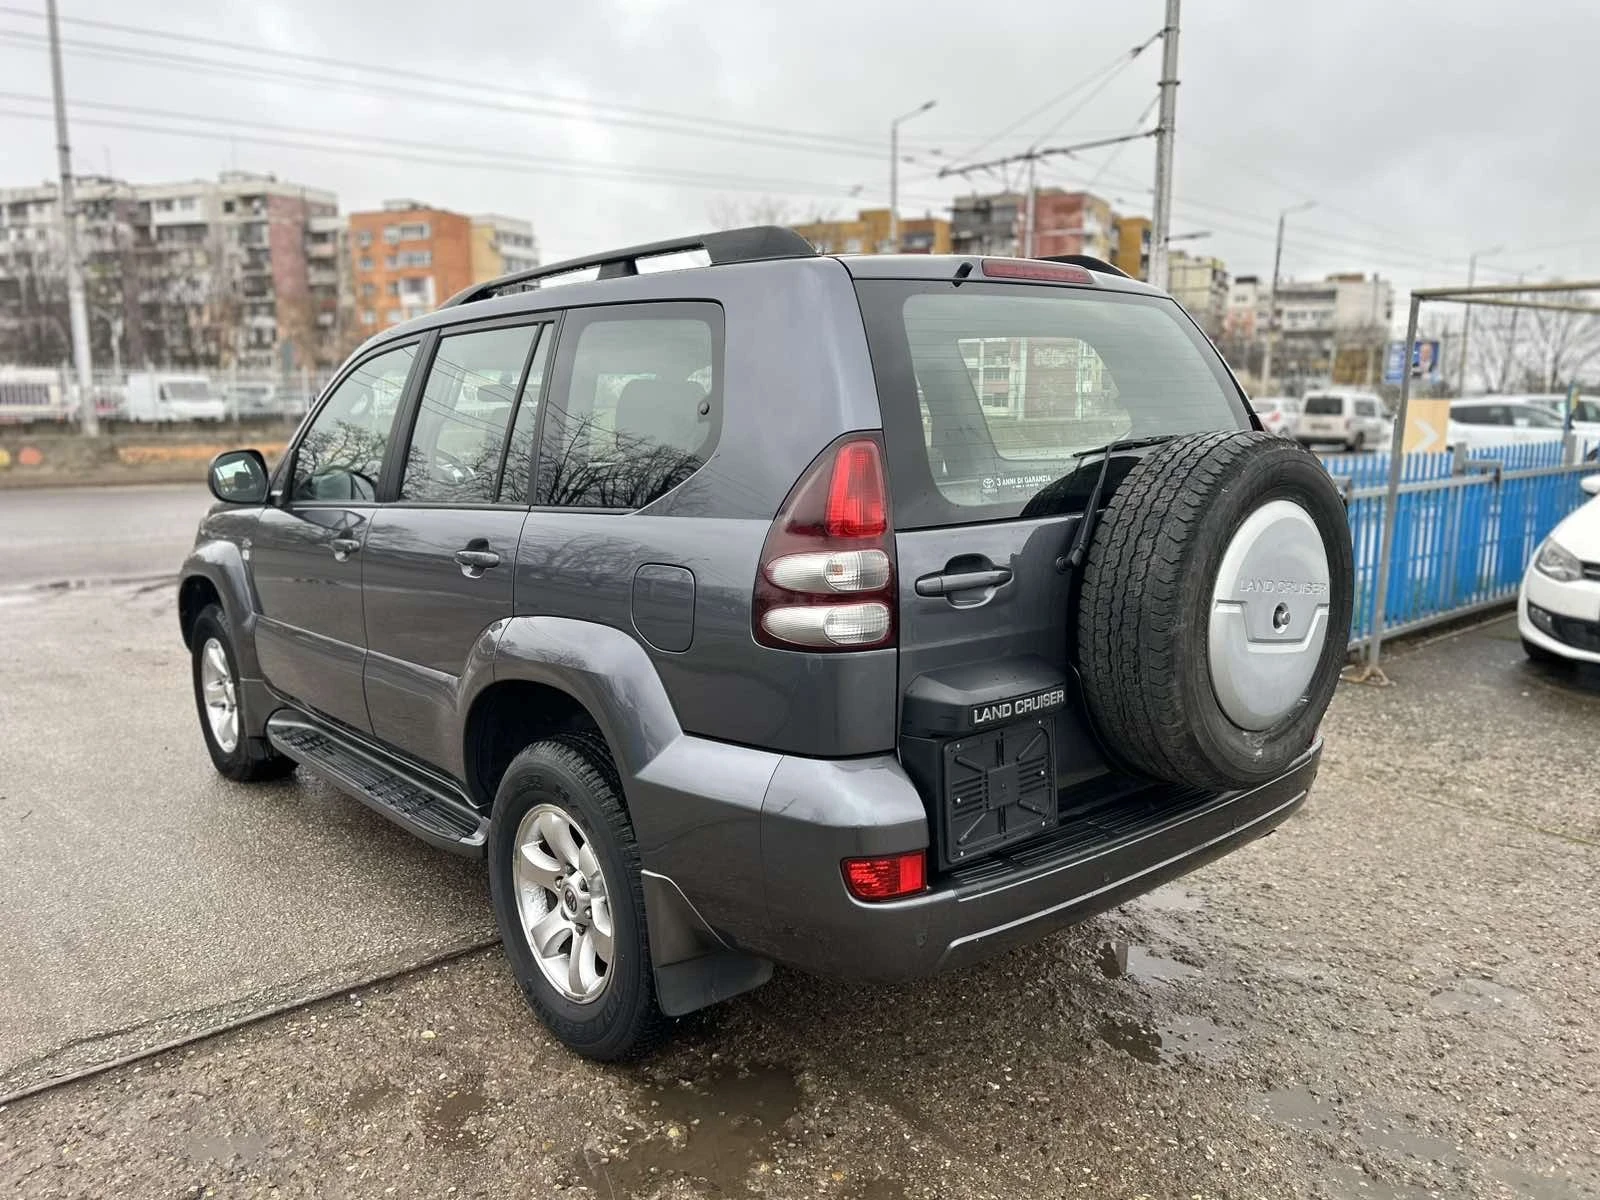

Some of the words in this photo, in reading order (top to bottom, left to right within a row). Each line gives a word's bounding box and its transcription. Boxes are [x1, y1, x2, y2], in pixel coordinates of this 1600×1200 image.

[1240, 579, 1274, 593] LAND
[1278, 580, 1327, 594] CRUISER
[974, 703, 1012, 724] LAND
[1015, 690, 1065, 715] CRUISER
